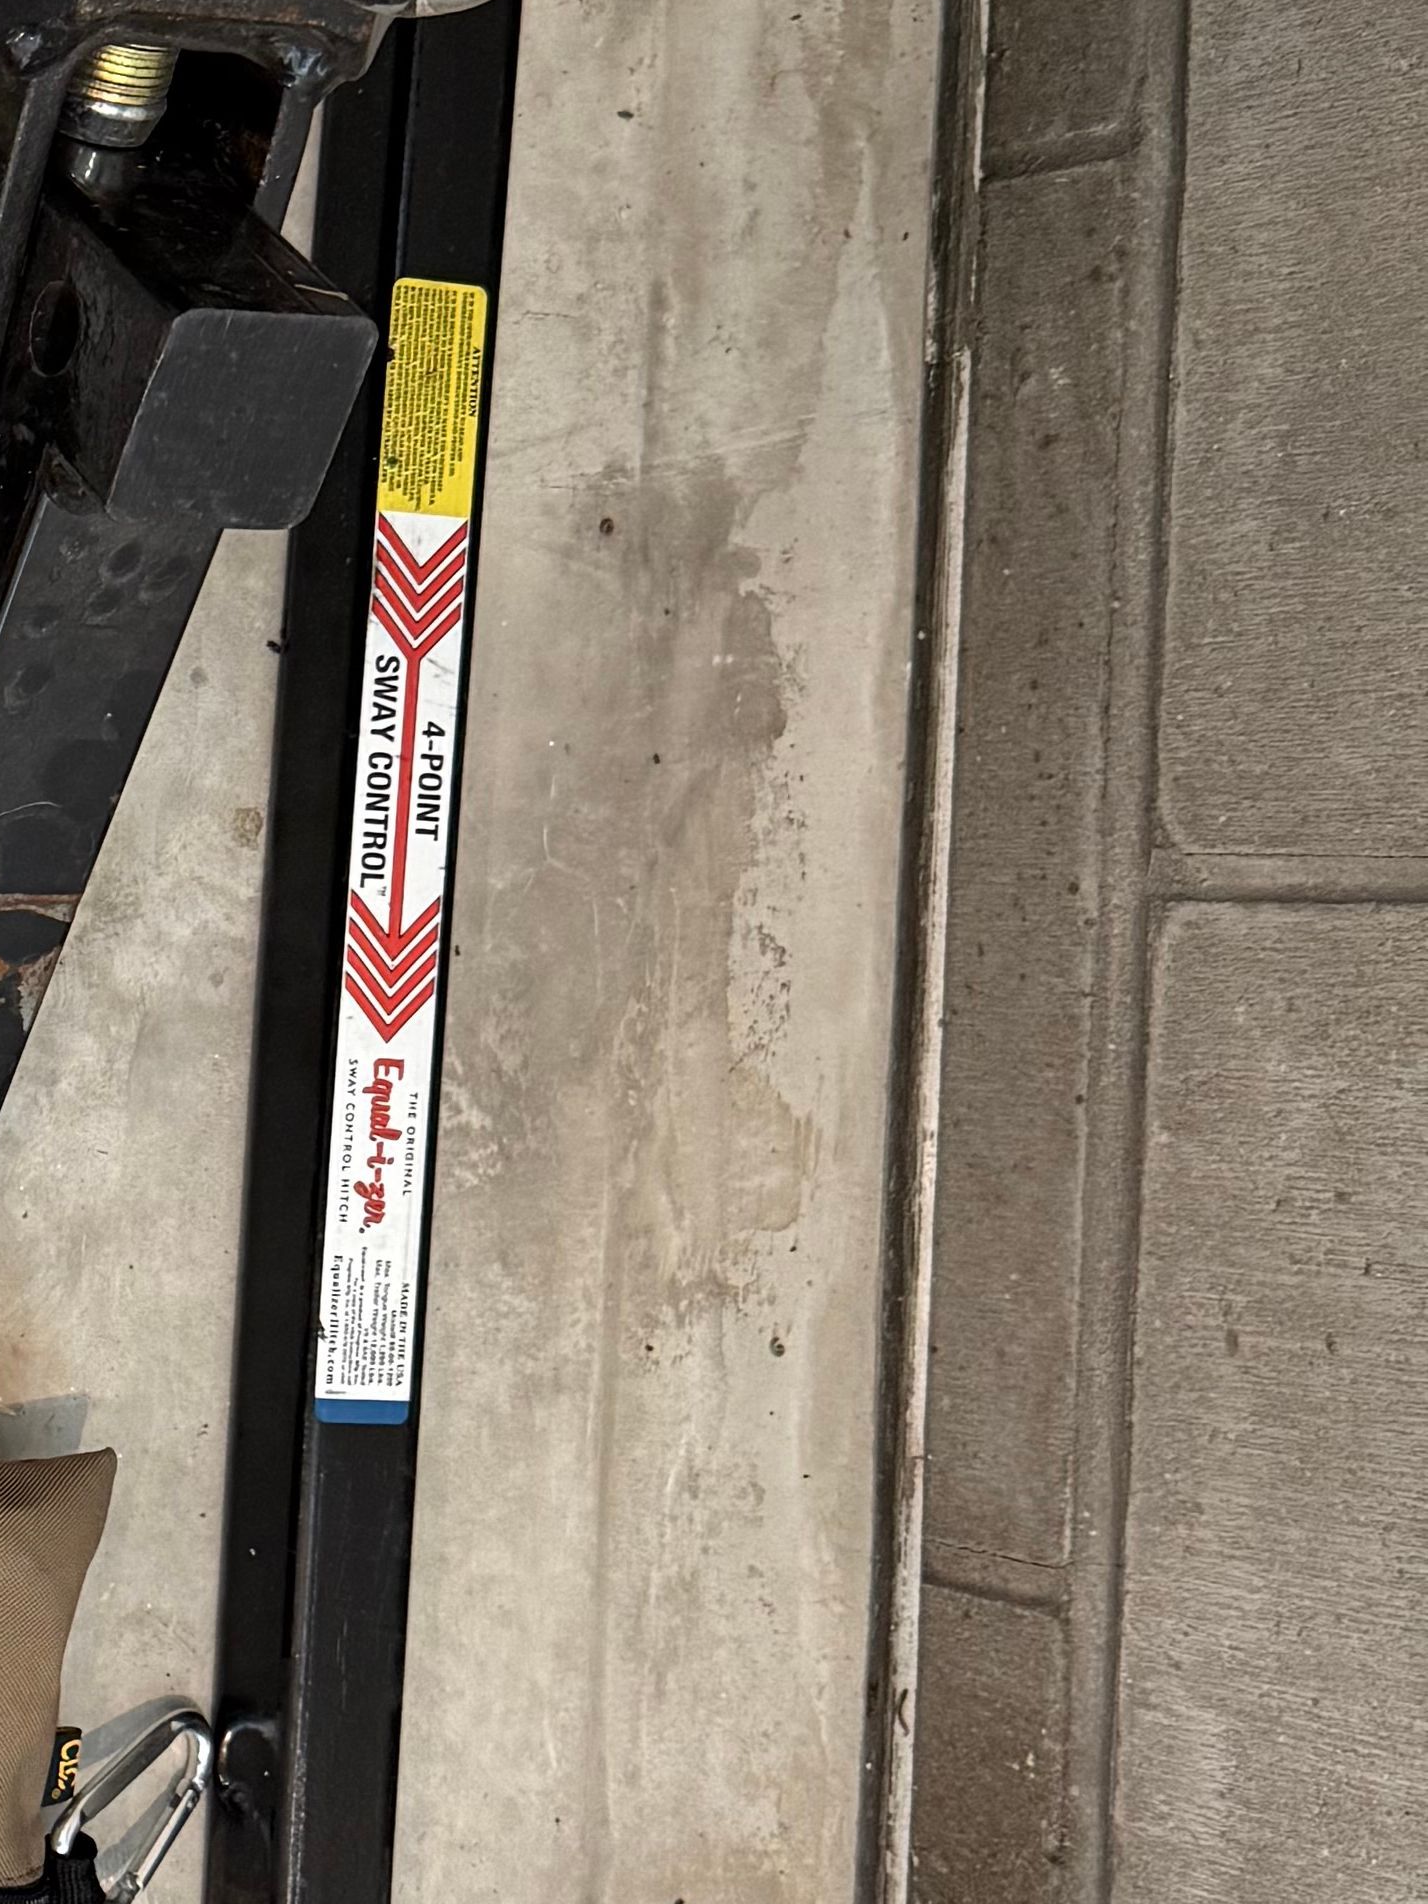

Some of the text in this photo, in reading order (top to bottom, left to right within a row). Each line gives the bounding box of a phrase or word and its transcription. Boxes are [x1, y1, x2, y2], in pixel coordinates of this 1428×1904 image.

[468, 346, 481, 417] ATTENTION
[370, 654, 400, 741] SWAY
[415, 721, 445, 841] 4-POINT
[338, 1058, 358, 1222] SWAY CONTROL HITCH
[401, 1091, 418, 1195] THE ORIGINAL
[394, 1282, 409, 1386] MADE IN THE USA
